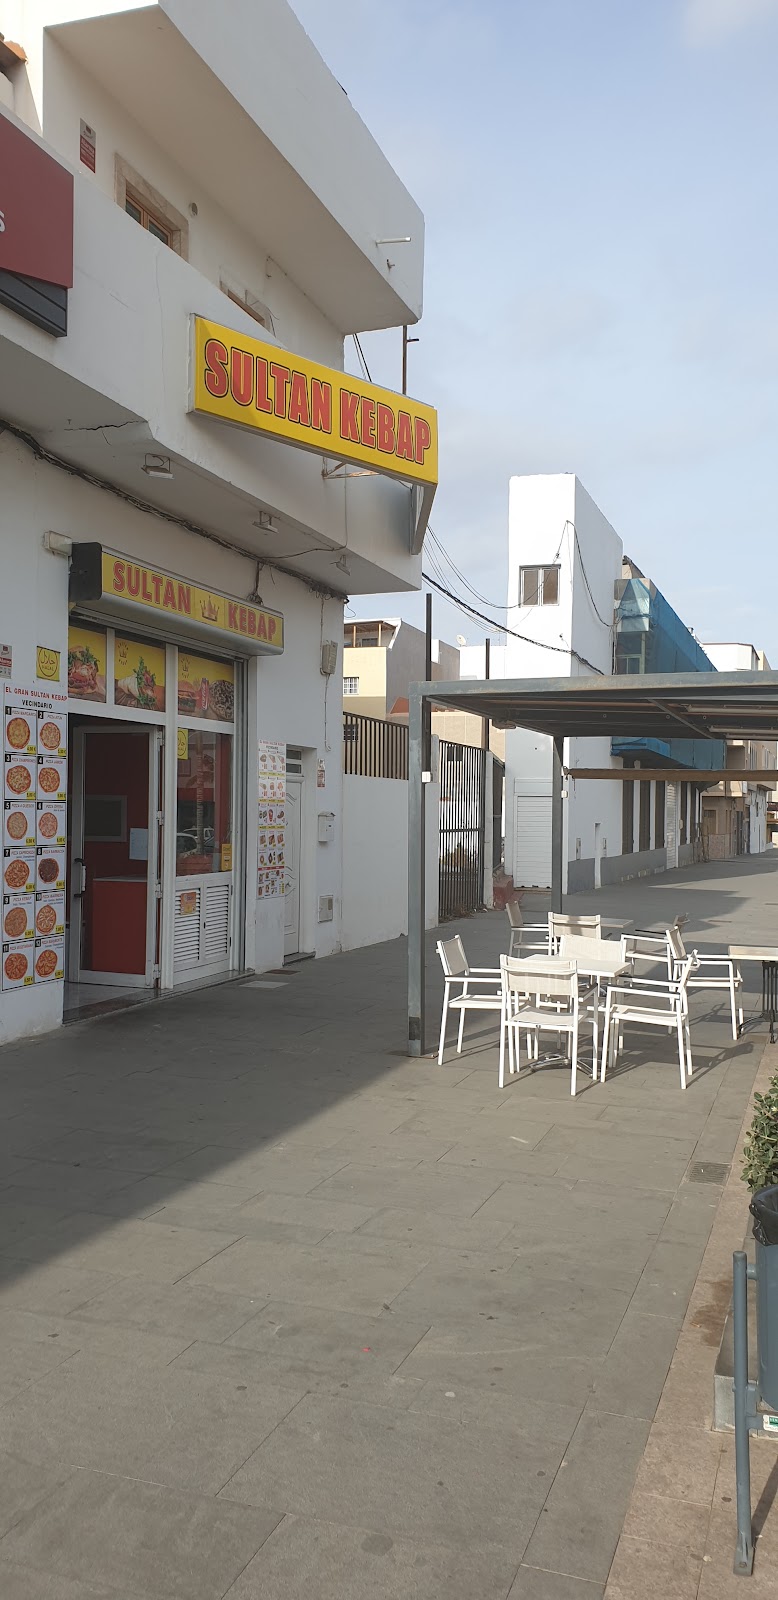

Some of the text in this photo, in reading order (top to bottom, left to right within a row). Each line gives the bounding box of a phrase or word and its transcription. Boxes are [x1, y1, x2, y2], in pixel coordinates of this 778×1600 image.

[205, 339, 431, 466] SULTAN KEBAP
[112, 560, 277, 642] SULTAN KEBAP
[22, 700, 52, 709] VECINDARIO
